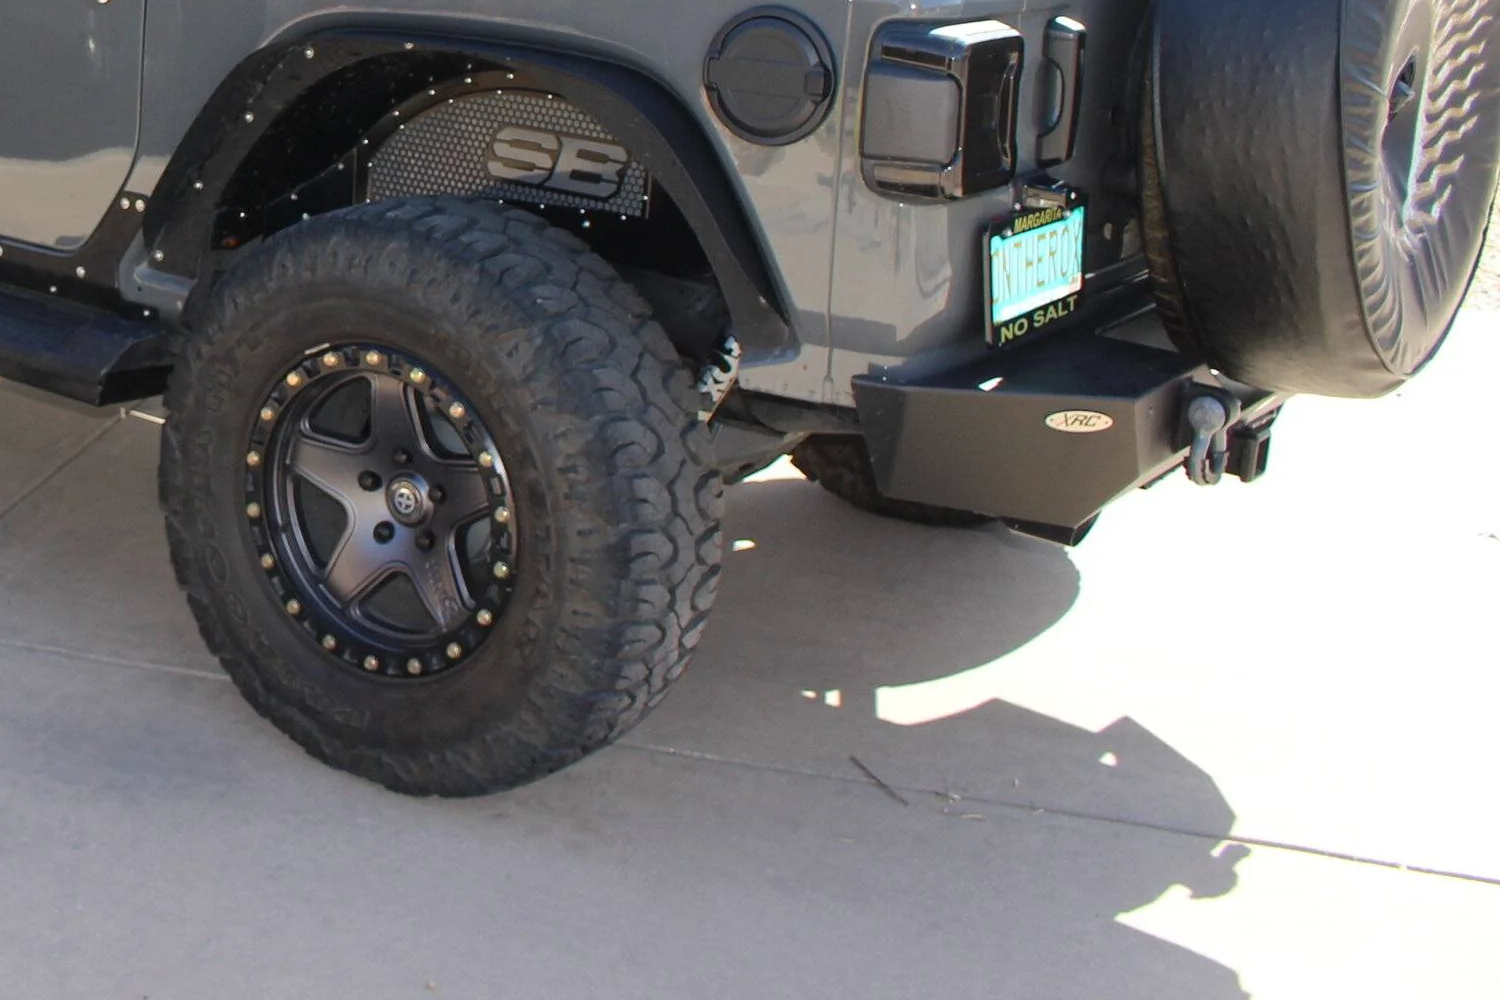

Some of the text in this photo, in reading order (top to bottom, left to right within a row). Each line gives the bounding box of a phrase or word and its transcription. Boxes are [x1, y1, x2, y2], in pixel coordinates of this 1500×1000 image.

[1013, 207, 1062, 233] MARGARITA
[1001, 296, 1078, 344] NO SALT
[1053, 411, 1102, 428] XRC
